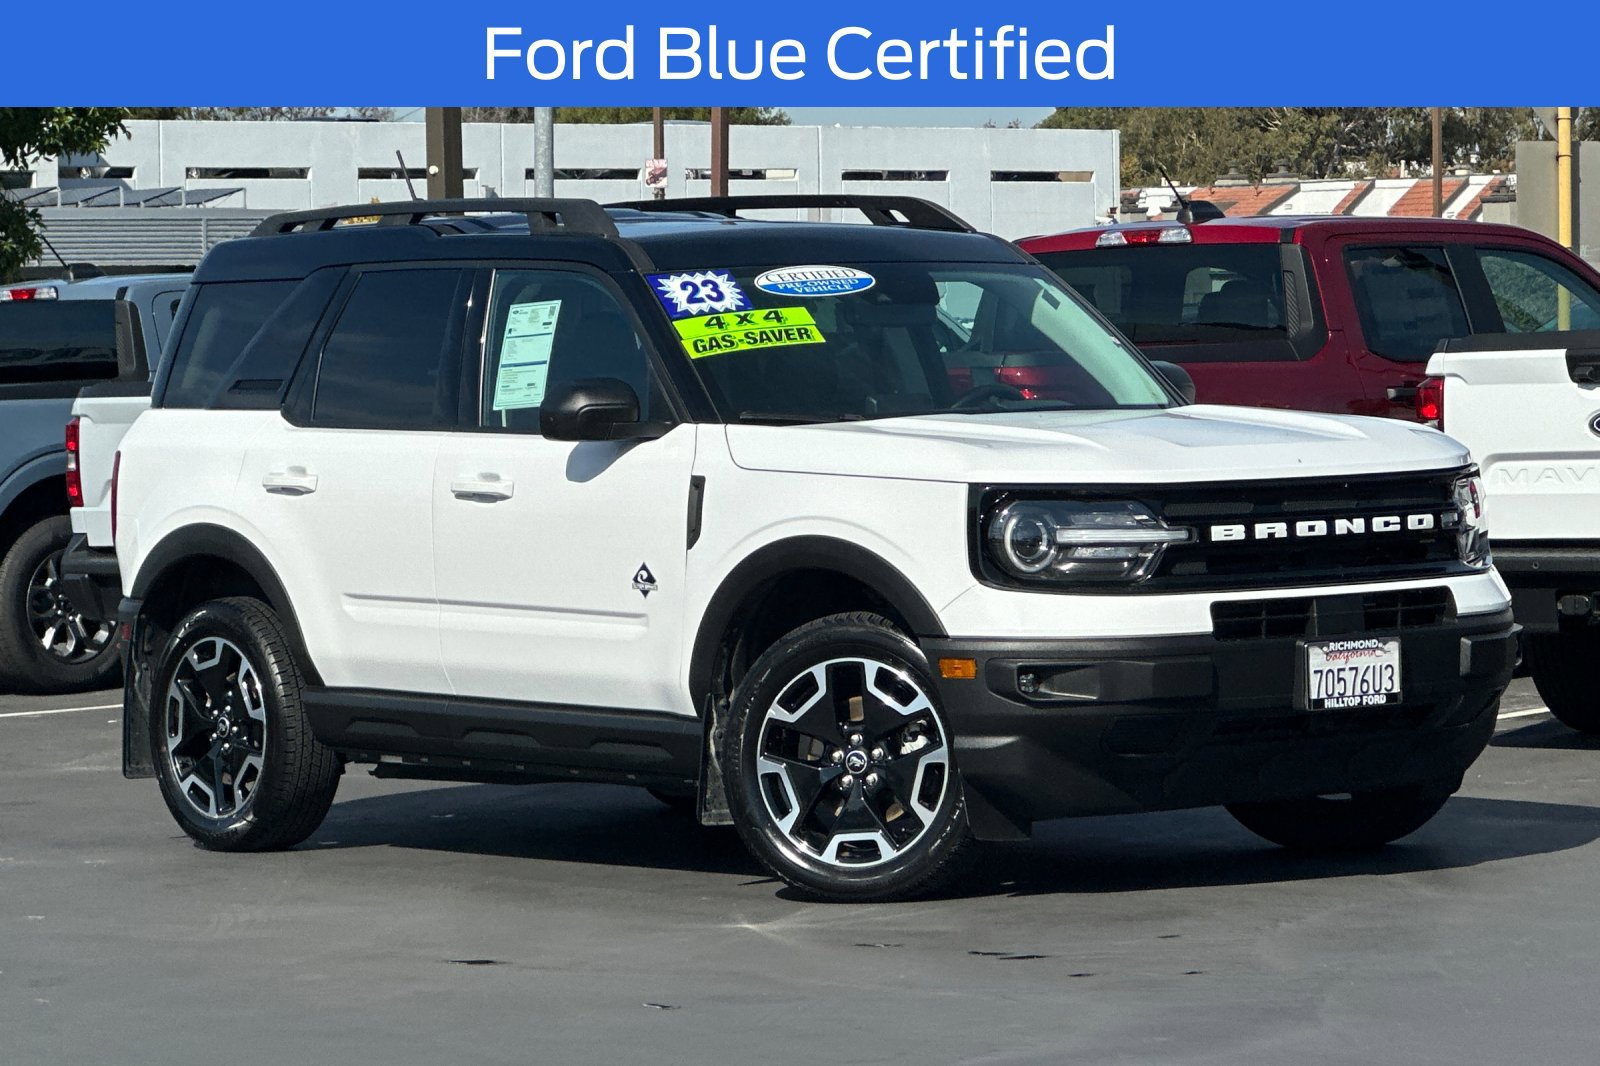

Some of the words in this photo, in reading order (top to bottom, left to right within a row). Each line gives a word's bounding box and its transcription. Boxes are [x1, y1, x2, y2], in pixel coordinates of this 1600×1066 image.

[766, 269, 857, 283] CERTIFIED
[777, 278, 859, 290] PRE-OWNED
[794, 283, 854, 293] VEHICLE
[680, 279, 726, 305] 23
[692, 327, 814, 354] GAS-SAVER
[1210, 513, 1435, 542] BRONCO
[1329, 639, 1378, 651] RICHMOND
[1313, 664, 1395, 699] 70576U3
[1324, 697, 1361, 709] HILLTOP
[1362, 694, 1387, 706] FORD
